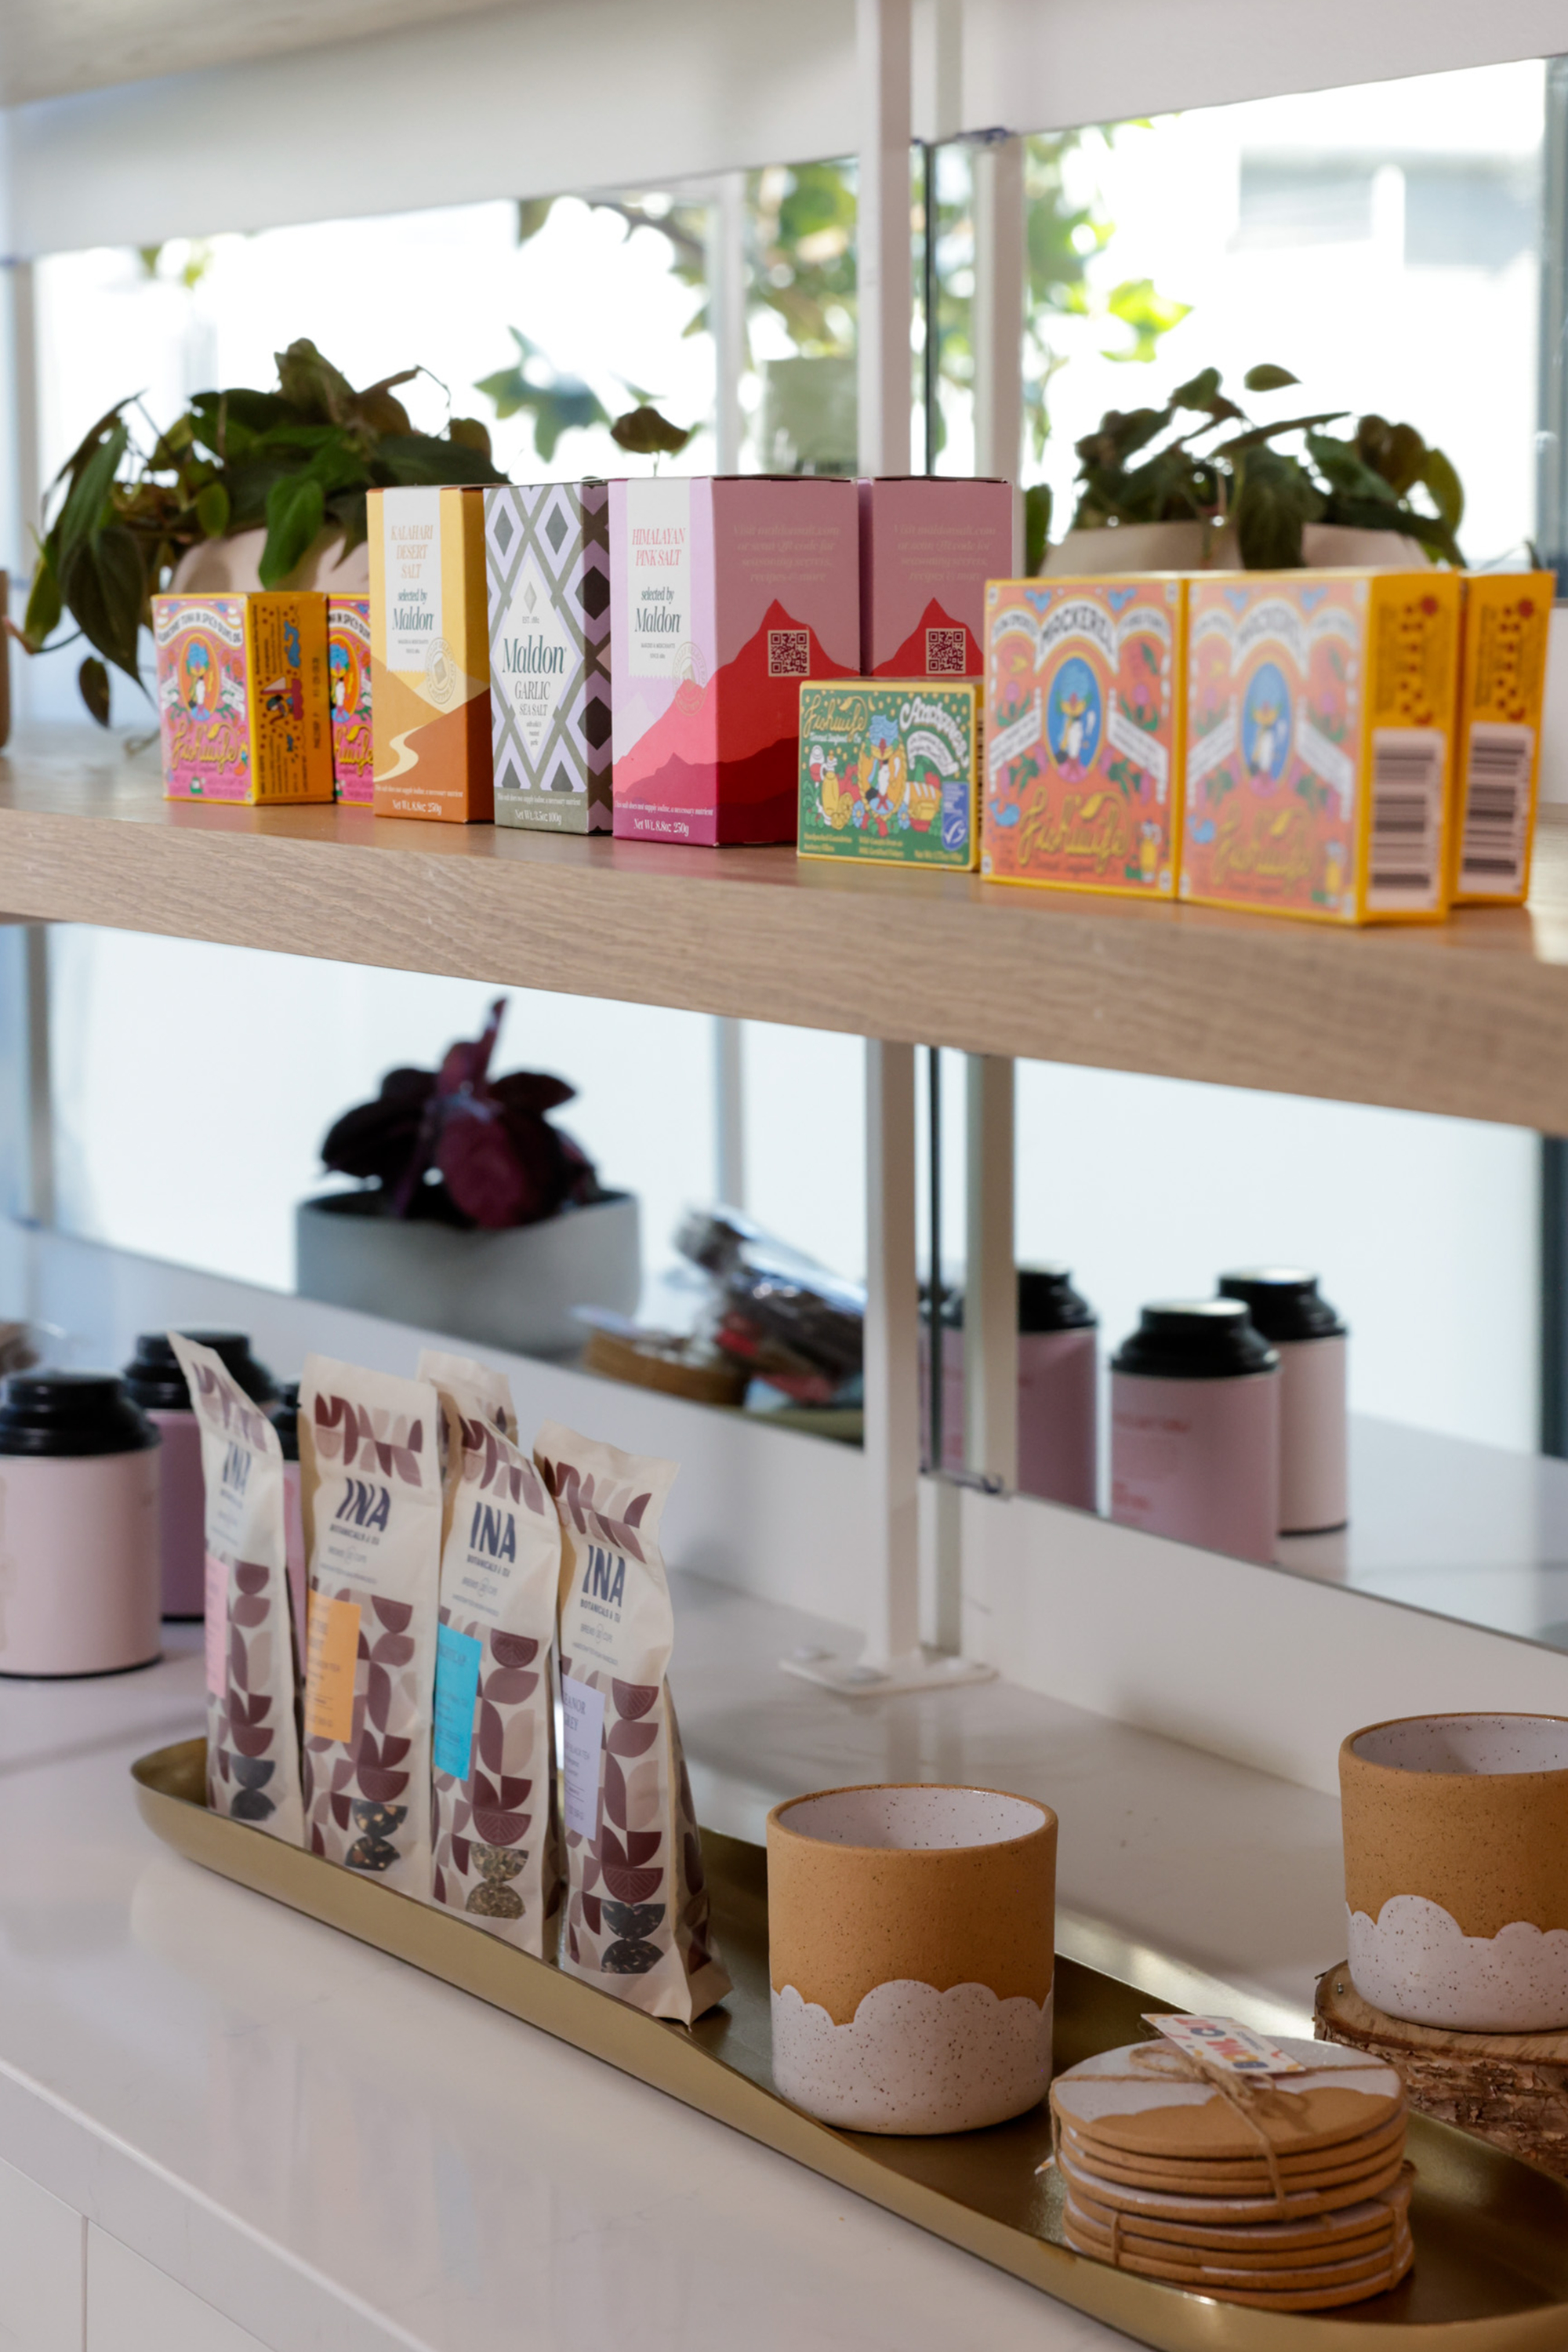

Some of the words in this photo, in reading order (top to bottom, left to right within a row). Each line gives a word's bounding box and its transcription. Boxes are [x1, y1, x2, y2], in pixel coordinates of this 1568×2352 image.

[391, 524, 434, 540] KALAHARI
[632, 528, 685, 545] HIMALAYAN
[397, 543, 428, 560] DESERT
[636, 549, 657, 566] PINK
[658, 548, 682, 566] SALT
[401, 564, 422, 579] SALT
[397, 588, 419, 601] selected
[420, 588, 427, 604] by
[641, 586, 665, 601] selected
[666, 586, 674, 604] by
[392, 606, 434, 630] Maldon
[635, 606, 681, 633] Maldon
[502, 635, 564, 674] Maldon
[514, 681, 550, 700] GARLIC
[519, 703, 532, 716] SEA
[532, 704, 548, 716] SALT
[392, 800, 401, 810] Net
[427, 802, 442, 816] 250g
[514, 809, 524, 820] Net
[549, 812, 562, 826] 100g
[633, 818, 644, 830] Net
[673, 822, 689, 837] 250g
[336, 1477, 390, 1532] INA
[470, 1501, 516, 1563] INA
[582, 1544, 626, 1608] INA
[580, 1599, 609, 1618] BOTANICALS
